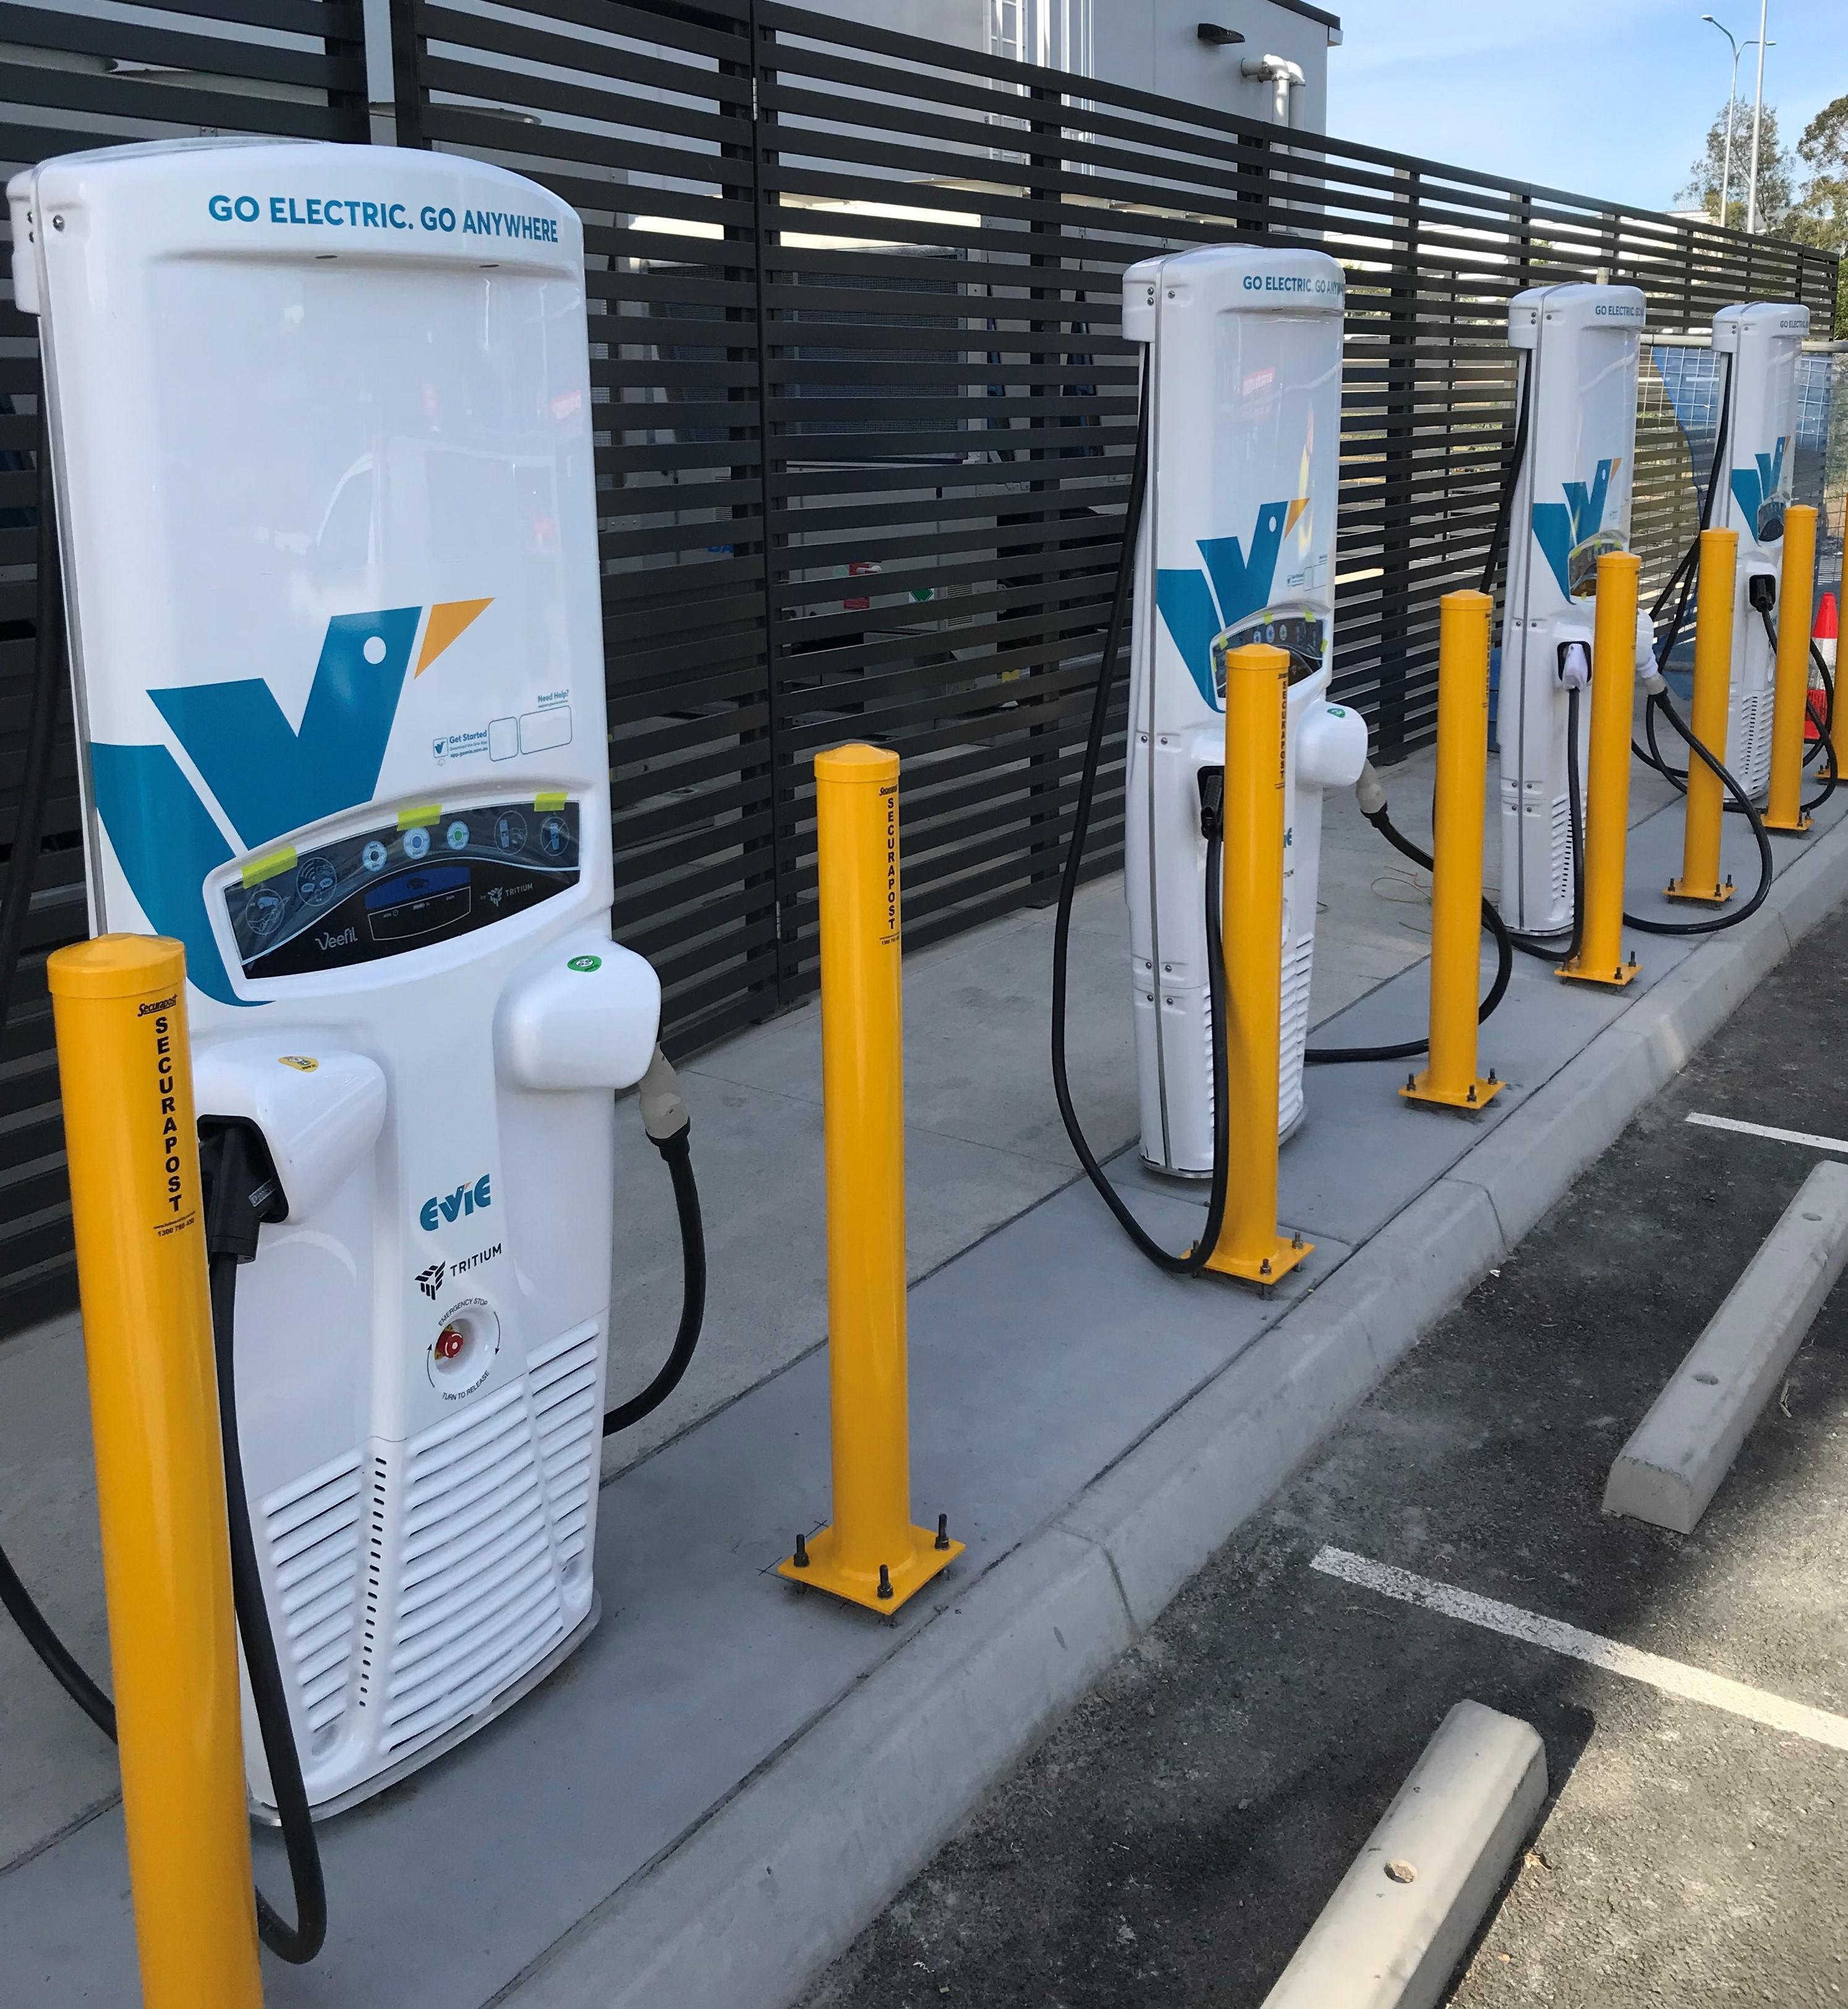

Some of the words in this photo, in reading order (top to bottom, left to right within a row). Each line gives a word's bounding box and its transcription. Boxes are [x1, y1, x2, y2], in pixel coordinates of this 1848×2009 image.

[208, 195, 260, 222] GO
[270, 197, 414, 229] ELECTRIC.
[420, 206, 456, 232] GO
[462, 210, 558, 243] ANYWHERE
[1243, 276, 1263, 290] GO
[1315, 279, 1326, 294] GO
[1595, 305, 1607, 315] GO
[538, 692, 553, 702] Need
[554, 689, 569, 699] Help?
[449, 735, 461, 744] Get
[462, 729, 487, 741] Started
[887, 797, 895, 929] SECURAPOST
[505, 882, 534, 897] TRITIUM
[315, 927, 359, 951] Veefil
[137, 994, 178, 1017] Securapost
[155, 1016, 182, 1213] SECURAPOST
[157, 1227, 174, 1237] 1300
[450, 1242, 502, 1277] TRITIUM
[438, 1298, 474, 1327] EMERGENCY
[474, 1298, 488, 1306] STOP
[441, 1391, 457, 1401] TURN
[458, 1391, 466, 1400] TO
[466, 1370, 490, 1396] RELEASE
